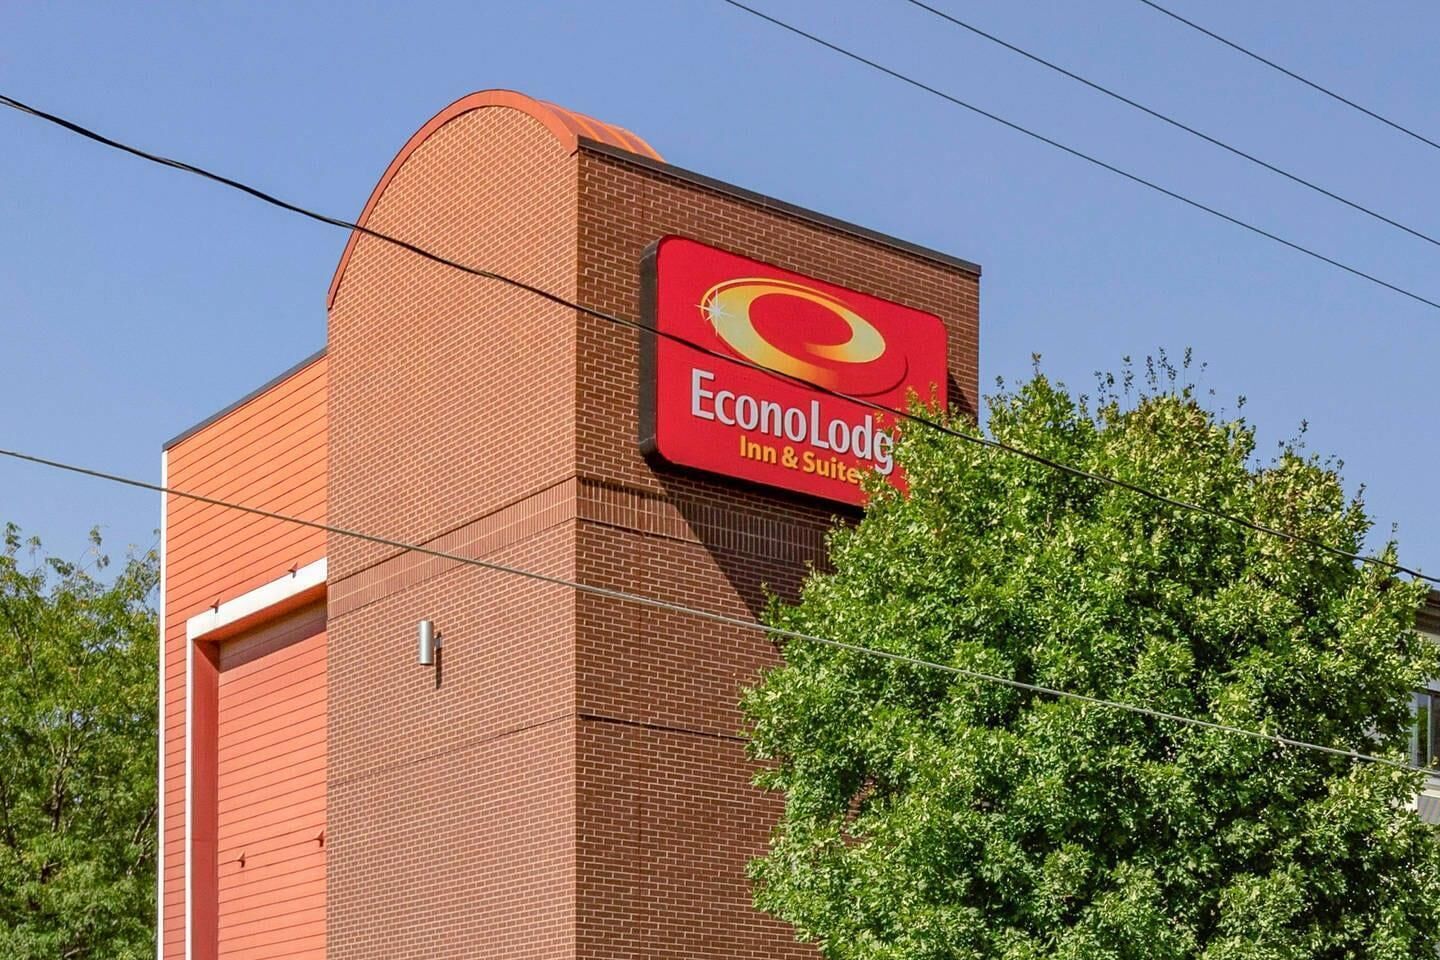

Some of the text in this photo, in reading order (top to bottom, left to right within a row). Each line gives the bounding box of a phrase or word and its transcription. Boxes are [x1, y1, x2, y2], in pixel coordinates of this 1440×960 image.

[691, 367, 895, 475] EconoLodg
[739, 434, 865, 485] Inn & Suite
